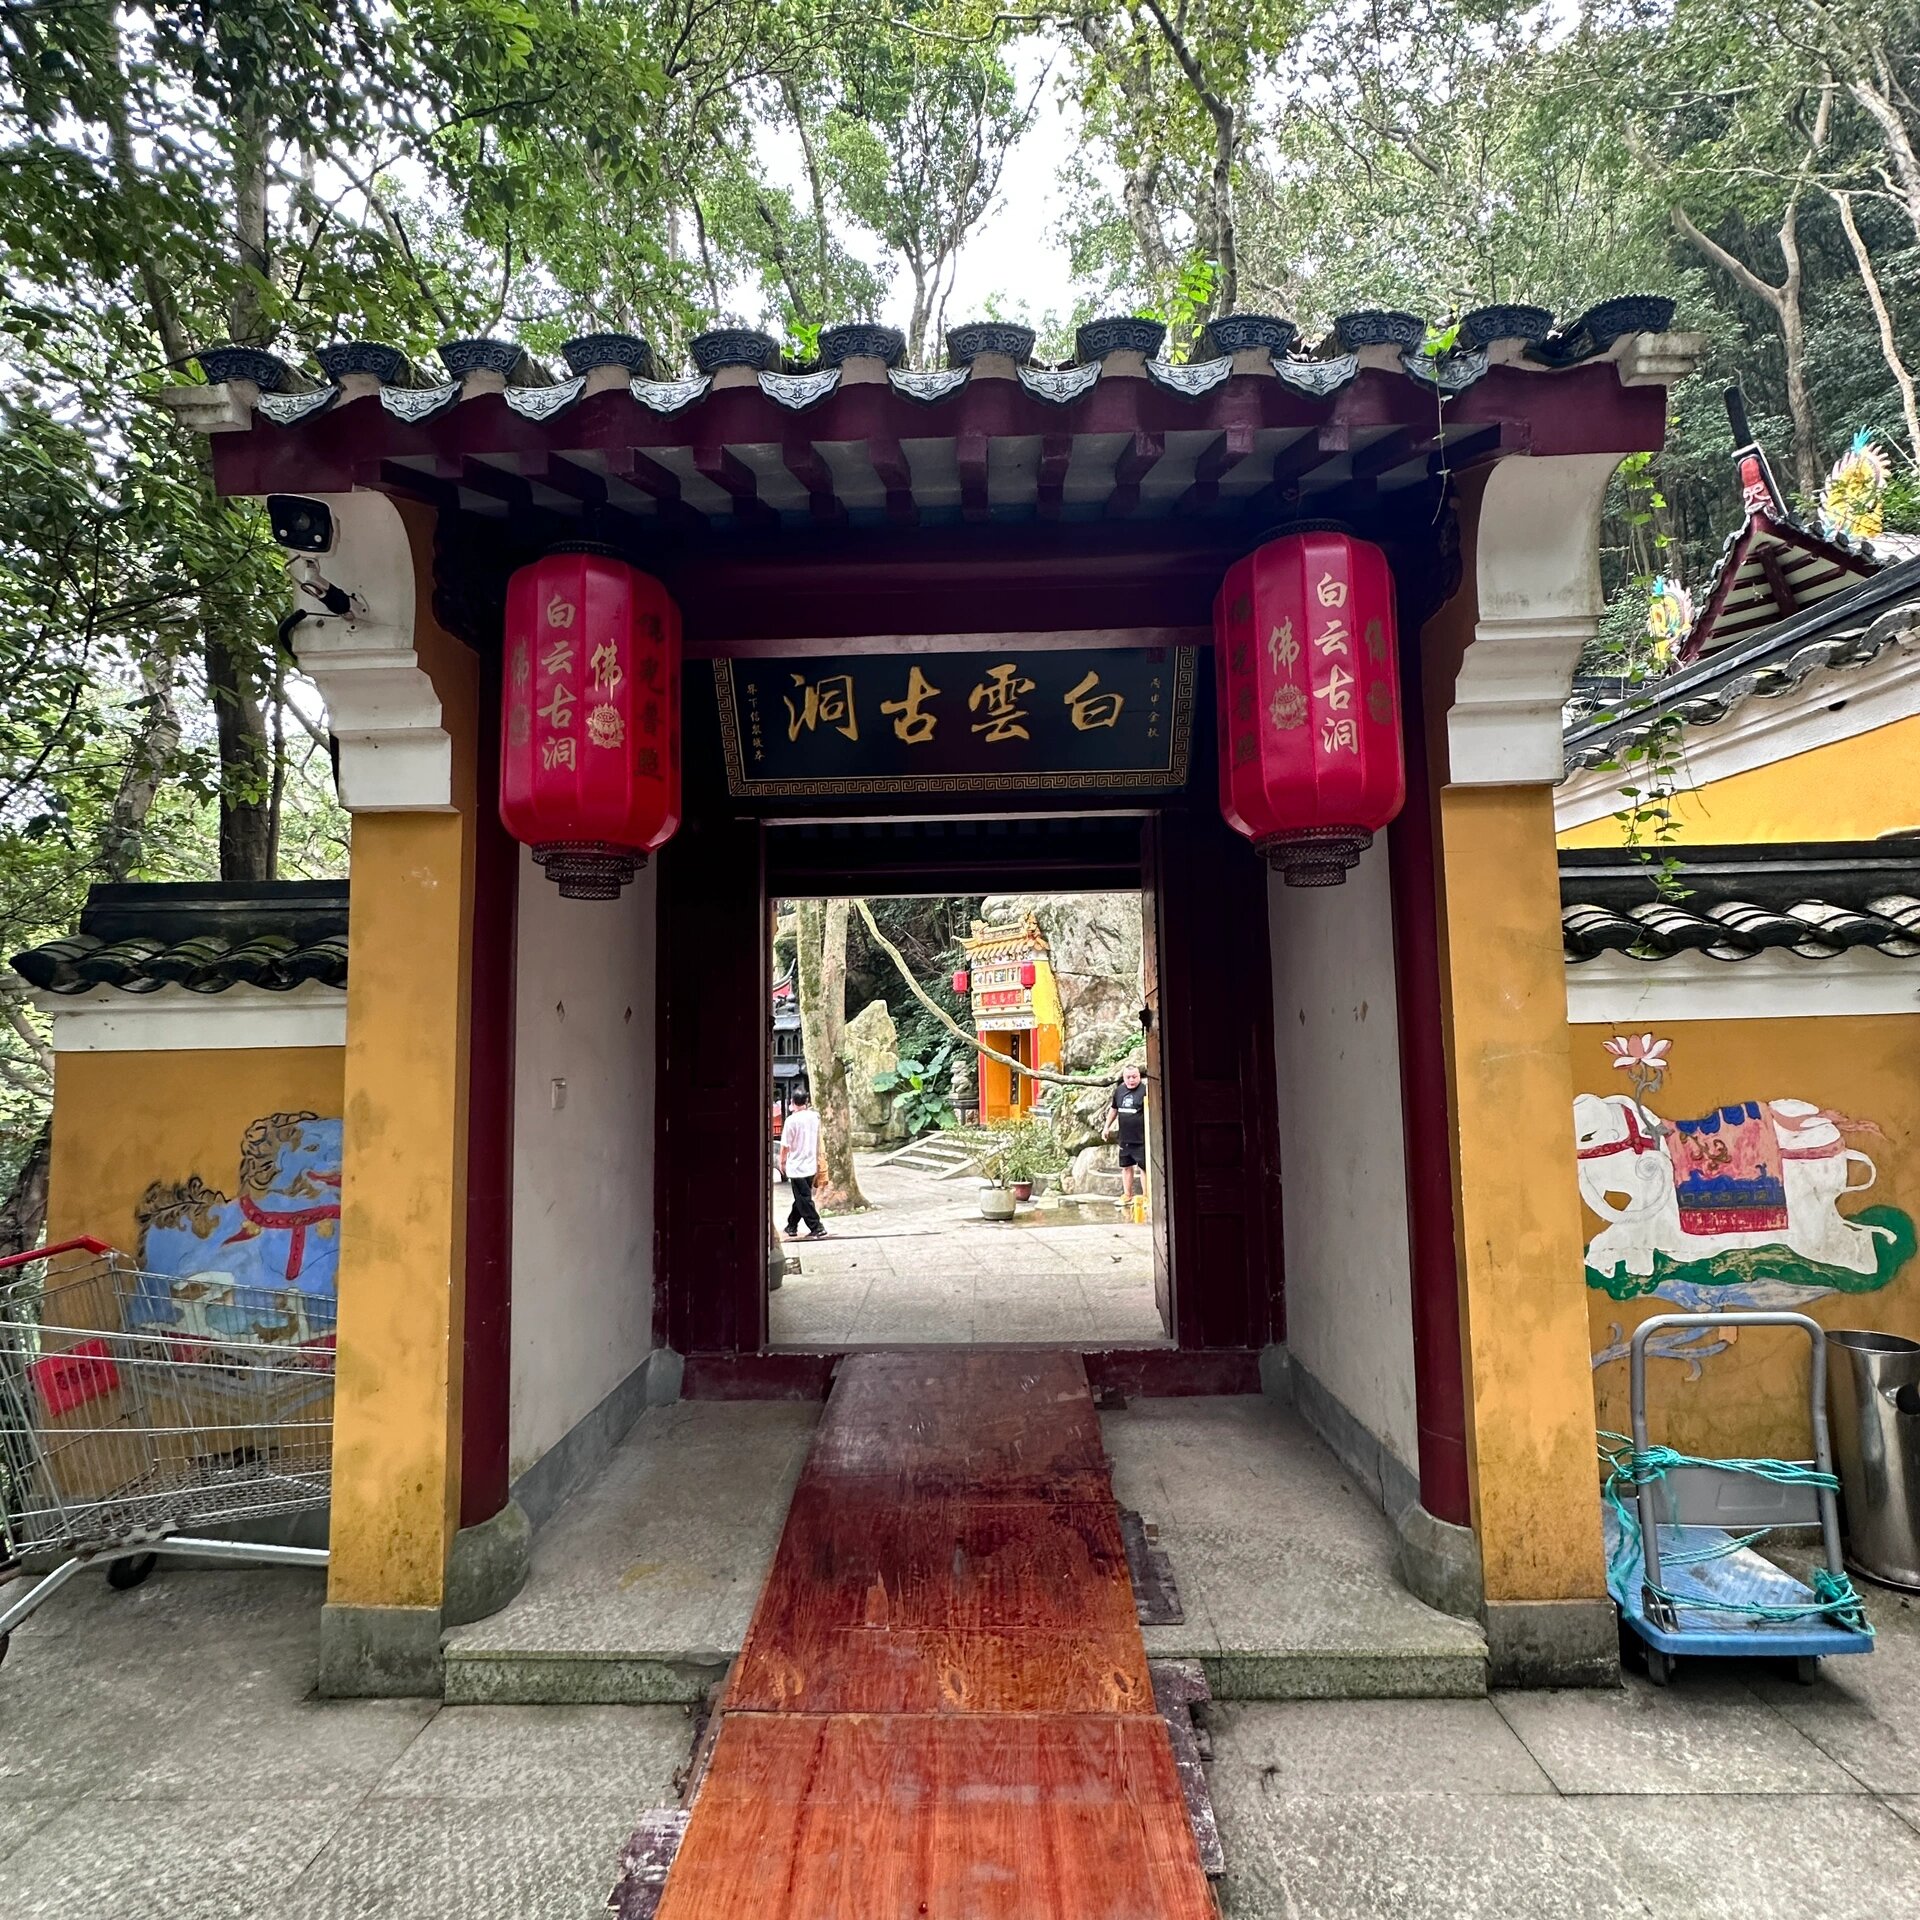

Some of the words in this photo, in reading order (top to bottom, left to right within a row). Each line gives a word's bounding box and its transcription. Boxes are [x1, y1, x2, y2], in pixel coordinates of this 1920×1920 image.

[537, 593, 577, 773] 白云古洞
[590, 638, 624, 701] 佛
[1268, 615, 1300, 680] 佛
[1312, 572, 1359, 755] 白云古洞
[783, 663, 1126, 744] 白雲古洞
